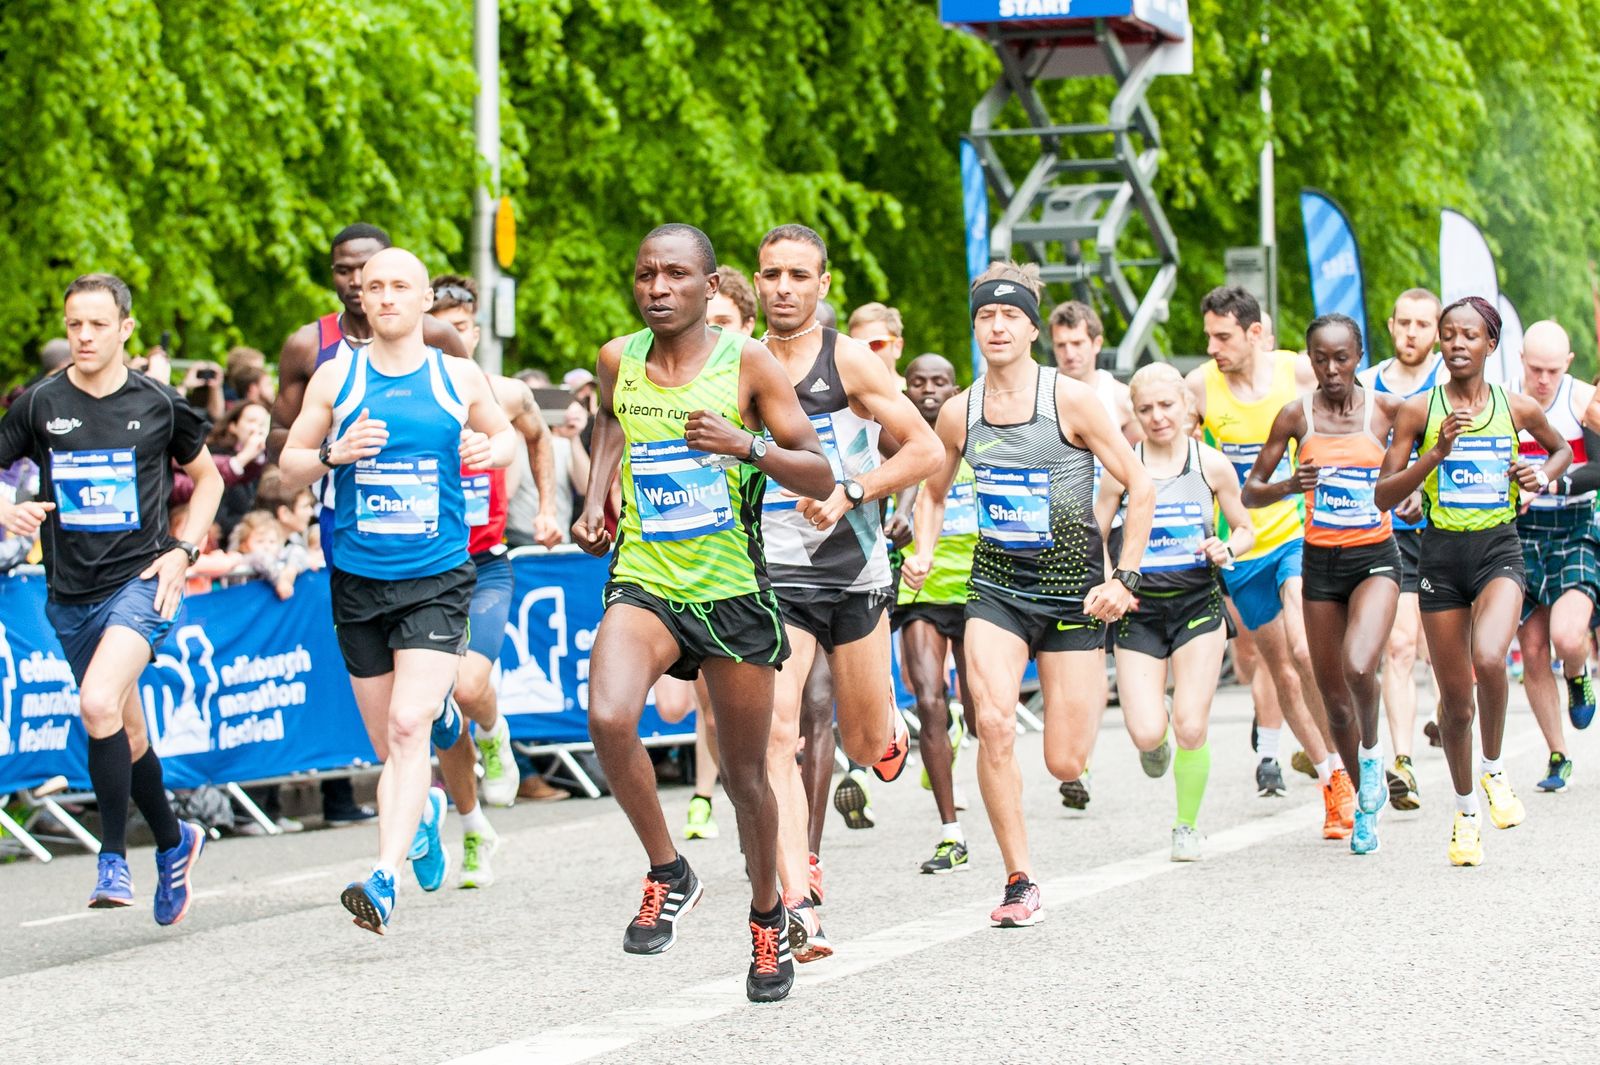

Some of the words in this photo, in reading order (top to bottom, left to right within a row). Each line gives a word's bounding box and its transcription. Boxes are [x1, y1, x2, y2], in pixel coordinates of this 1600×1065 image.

[999, 0, 1070, 17] START
[629, 403, 663, 418] team
[647, 445, 689, 456] marathon
[1458, 440, 1492, 448] marathon
[79, 485, 116, 507] 157
[366, 494, 434, 512] Charles
[643, 482, 723, 507] Wanjiru
[988, 504, 1041, 522] Shafar
